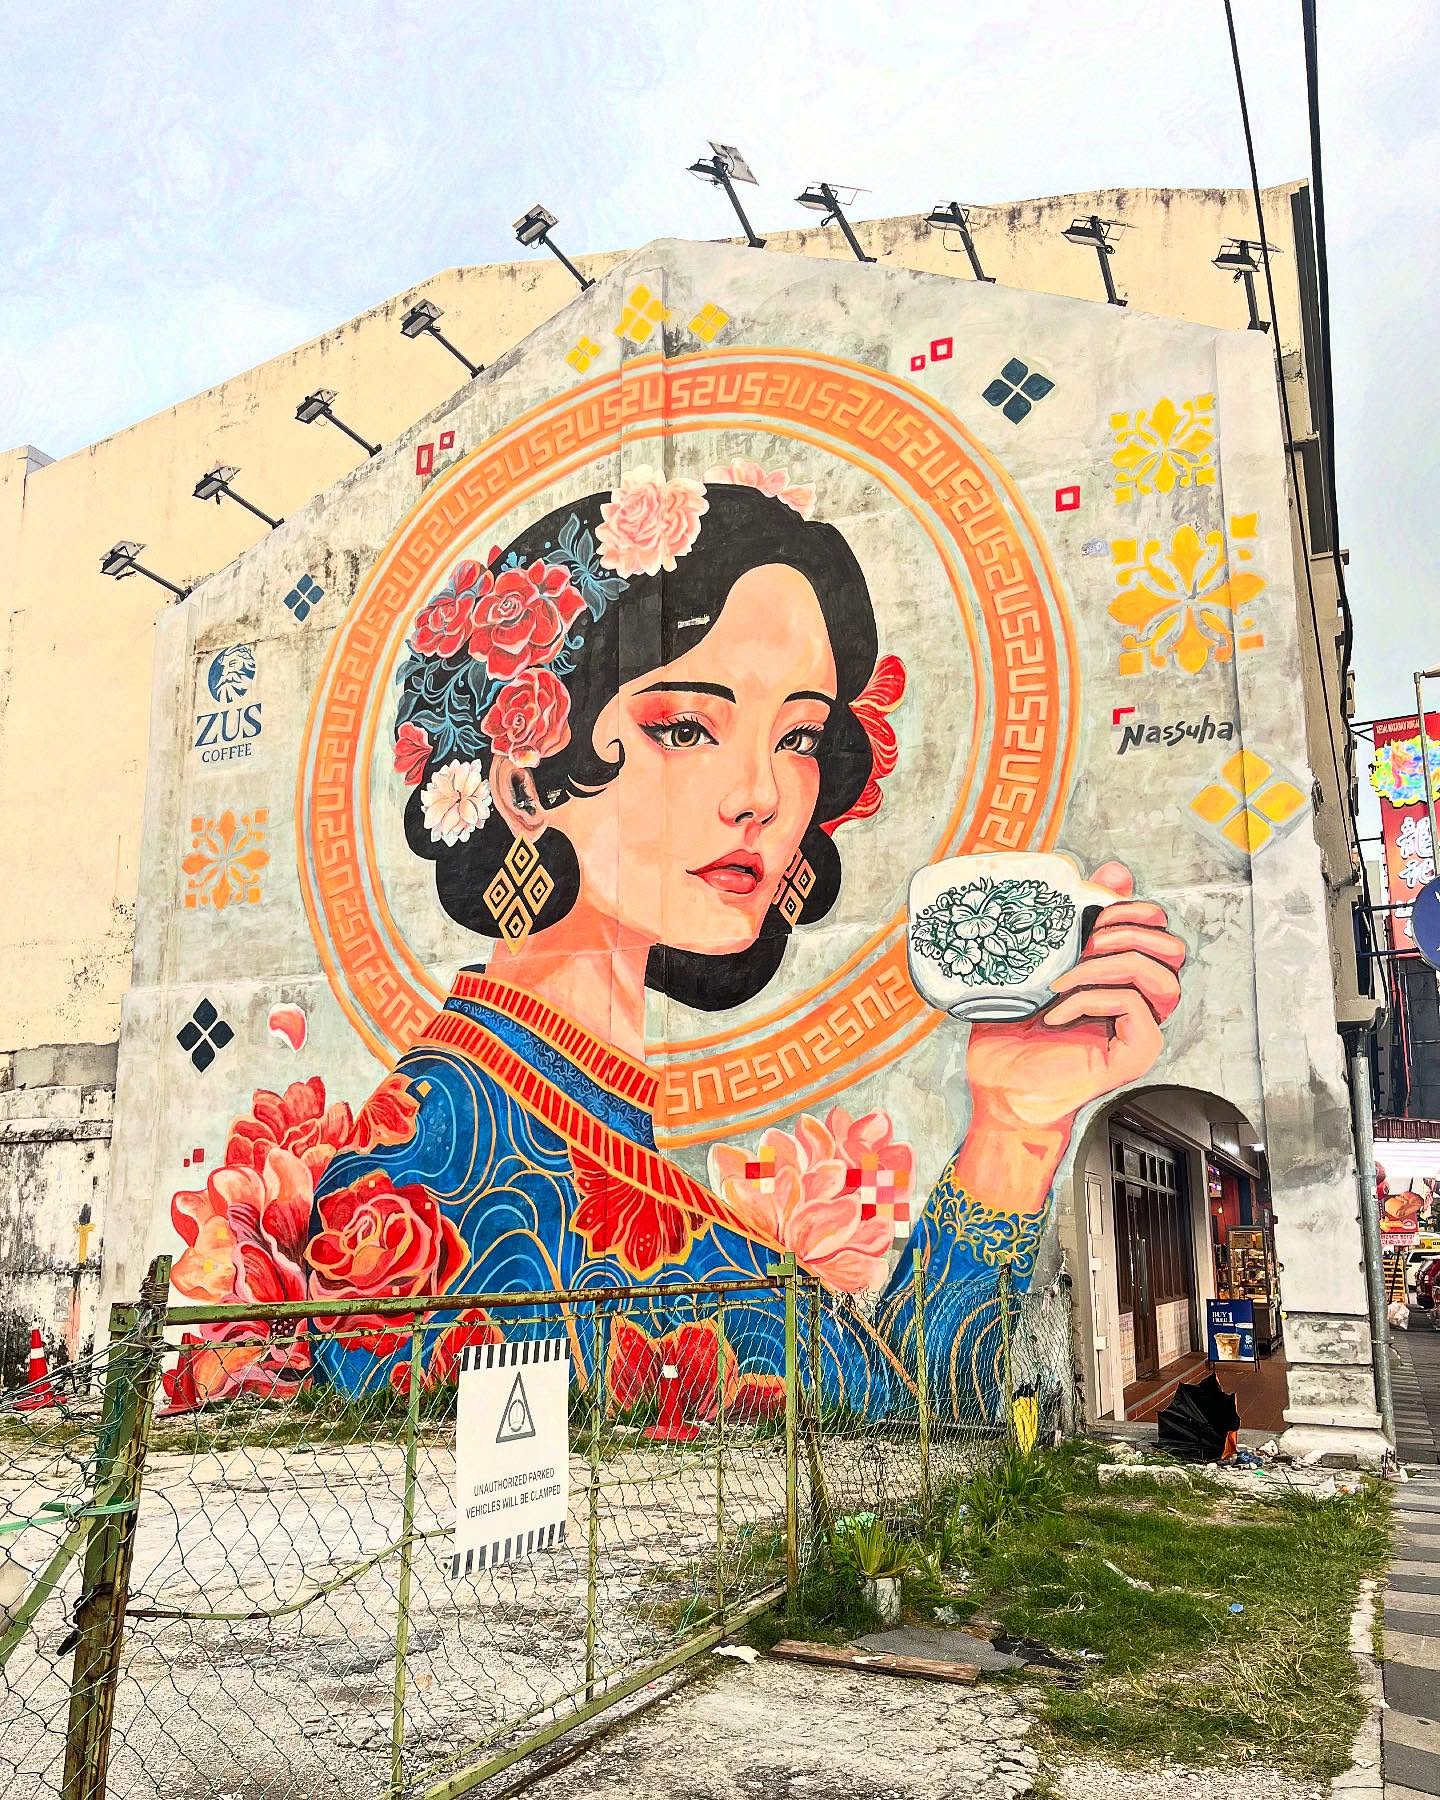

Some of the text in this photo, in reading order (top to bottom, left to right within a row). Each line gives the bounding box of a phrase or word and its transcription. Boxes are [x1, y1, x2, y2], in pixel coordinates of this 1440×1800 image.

[195, 703, 262, 747] ZUS
[1117, 715, 1233, 755] Nassuha
[202, 743, 252, 762] COFFEE
[473, 1467, 555, 1497] UNAUTHORIZED PARKED
[465, 1484, 561, 1520] VEHICLES WILL BE CLAMPED
